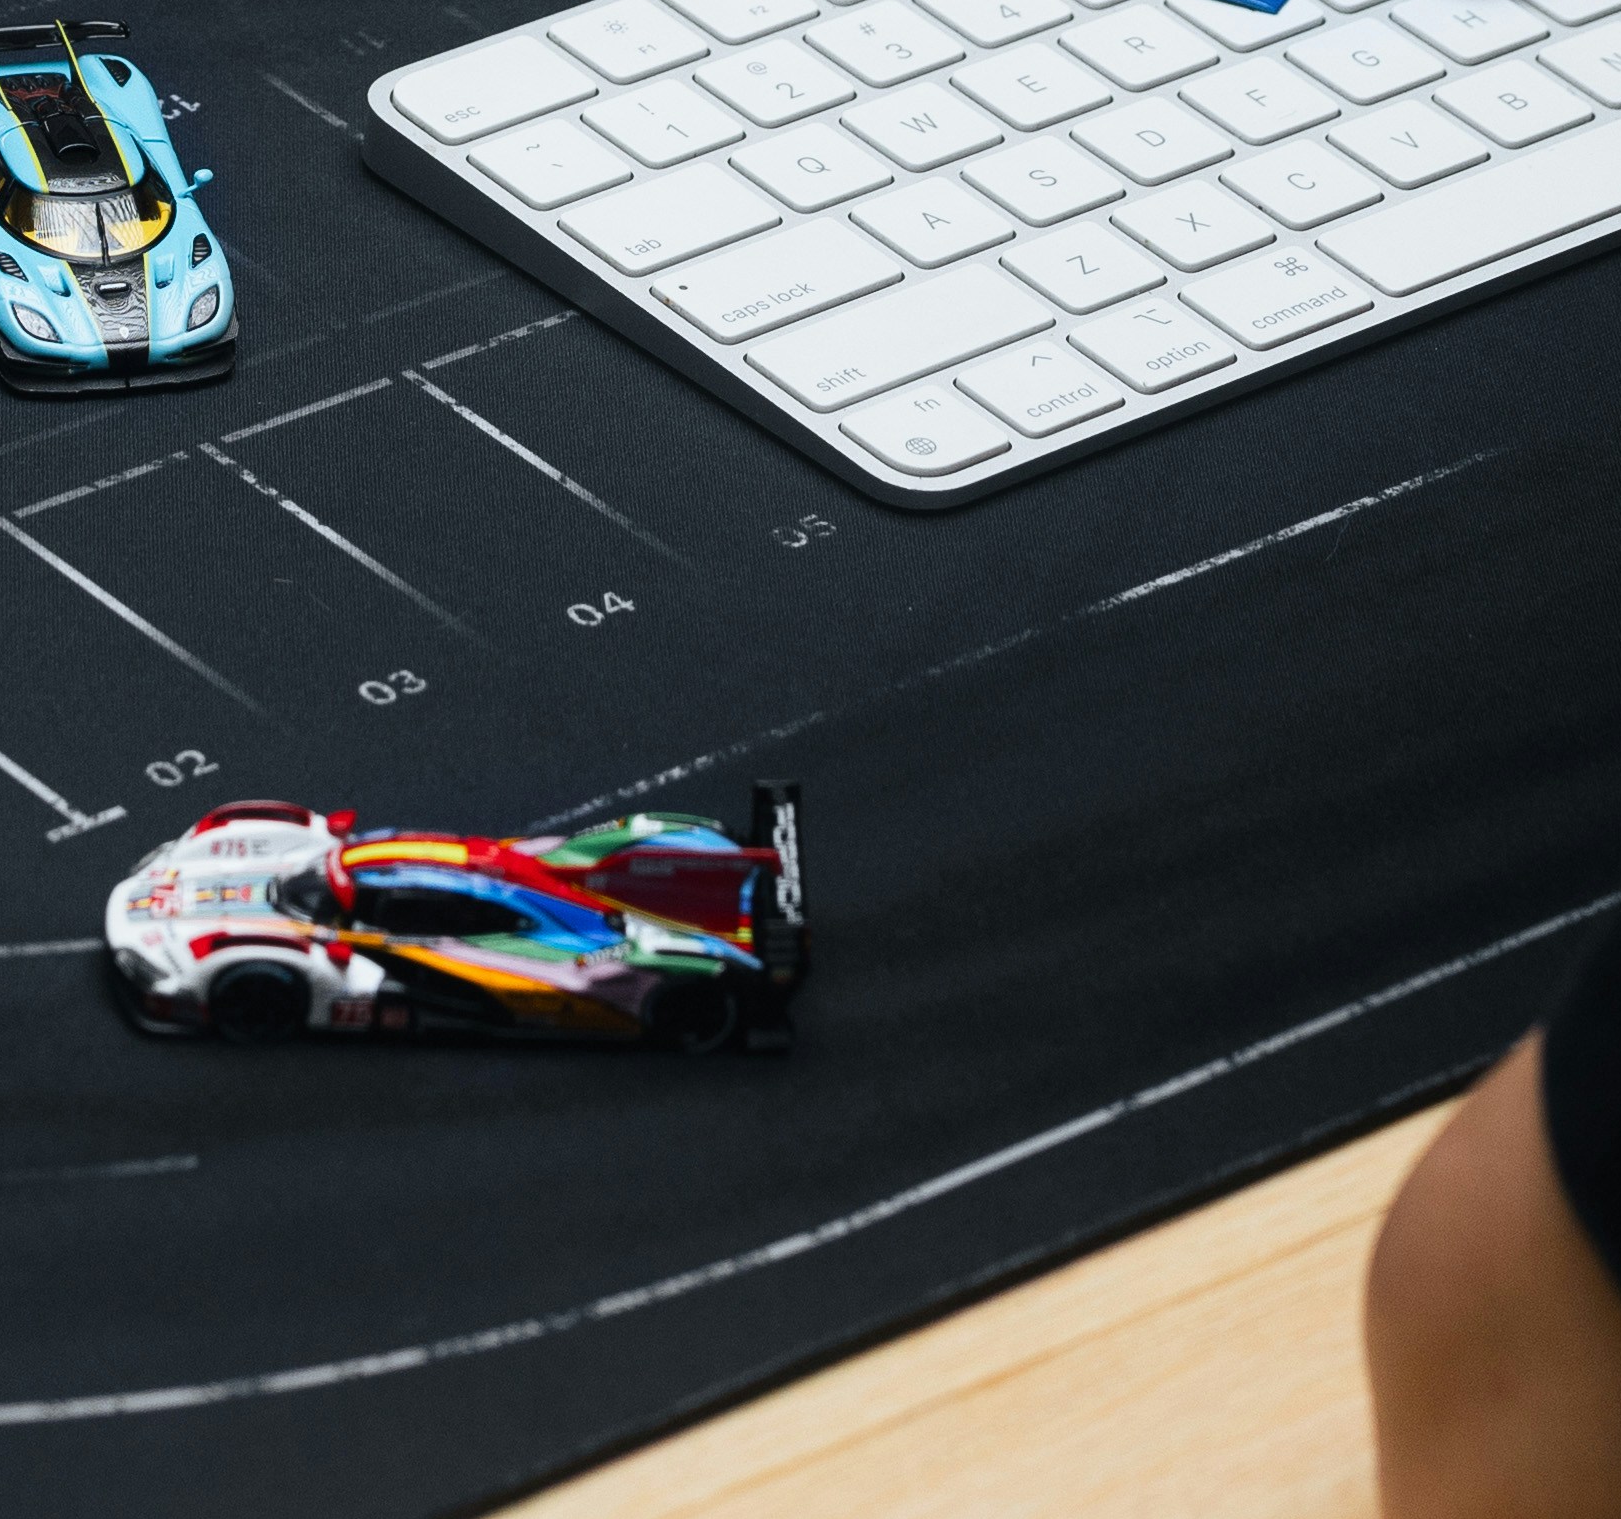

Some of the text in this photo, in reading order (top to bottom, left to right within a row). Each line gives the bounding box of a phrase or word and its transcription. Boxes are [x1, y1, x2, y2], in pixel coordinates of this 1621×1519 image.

[749, 3, 769, 17] F2
[999, 4, 1022, 22] 4
[1453, 9, 1489, 30] H
[859, 21, 877, 36] #
[637, 42, 657, 56] F1
[885, 42, 914, 61] 3
[1123, 36, 1156, 55] R
[746, 60, 768, 76] @
[1351, 49, 1380, 69] G
[775, 81, 805, 100] 2
[1017, 75, 1048, 94] E
[1244, 88, 1268, 108] F
[1497, 92, 1529, 111] B
[444, 103, 481, 125] esc
[899, 112, 940, 135] W
[665, 122, 690, 139] 1
[1135, 129, 1166, 148] D
[1389, 131, 1420, 150] V
[797, 156, 832, 175] Q
[1028, 168, 1058, 188] S
[1287, 172, 1316, 191] C
[921, 211, 951, 231] A
[1176, 212, 1212, 233] X
[624, 235, 663, 258] tab
[1066, 254, 1101, 276] Z
[722, 280, 816, 325] caps lock
[1252, 285, 1348, 330] command
[1146, 340, 1211, 371] option
[816, 364, 867, 394] shift
[913, 395, 942, 414] fn
[1026, 383, 1099, 419] control
[566, 590, 637, 628] 04
[358, 668, 427, 707] 03
[144, 748, 219, 788] 02
